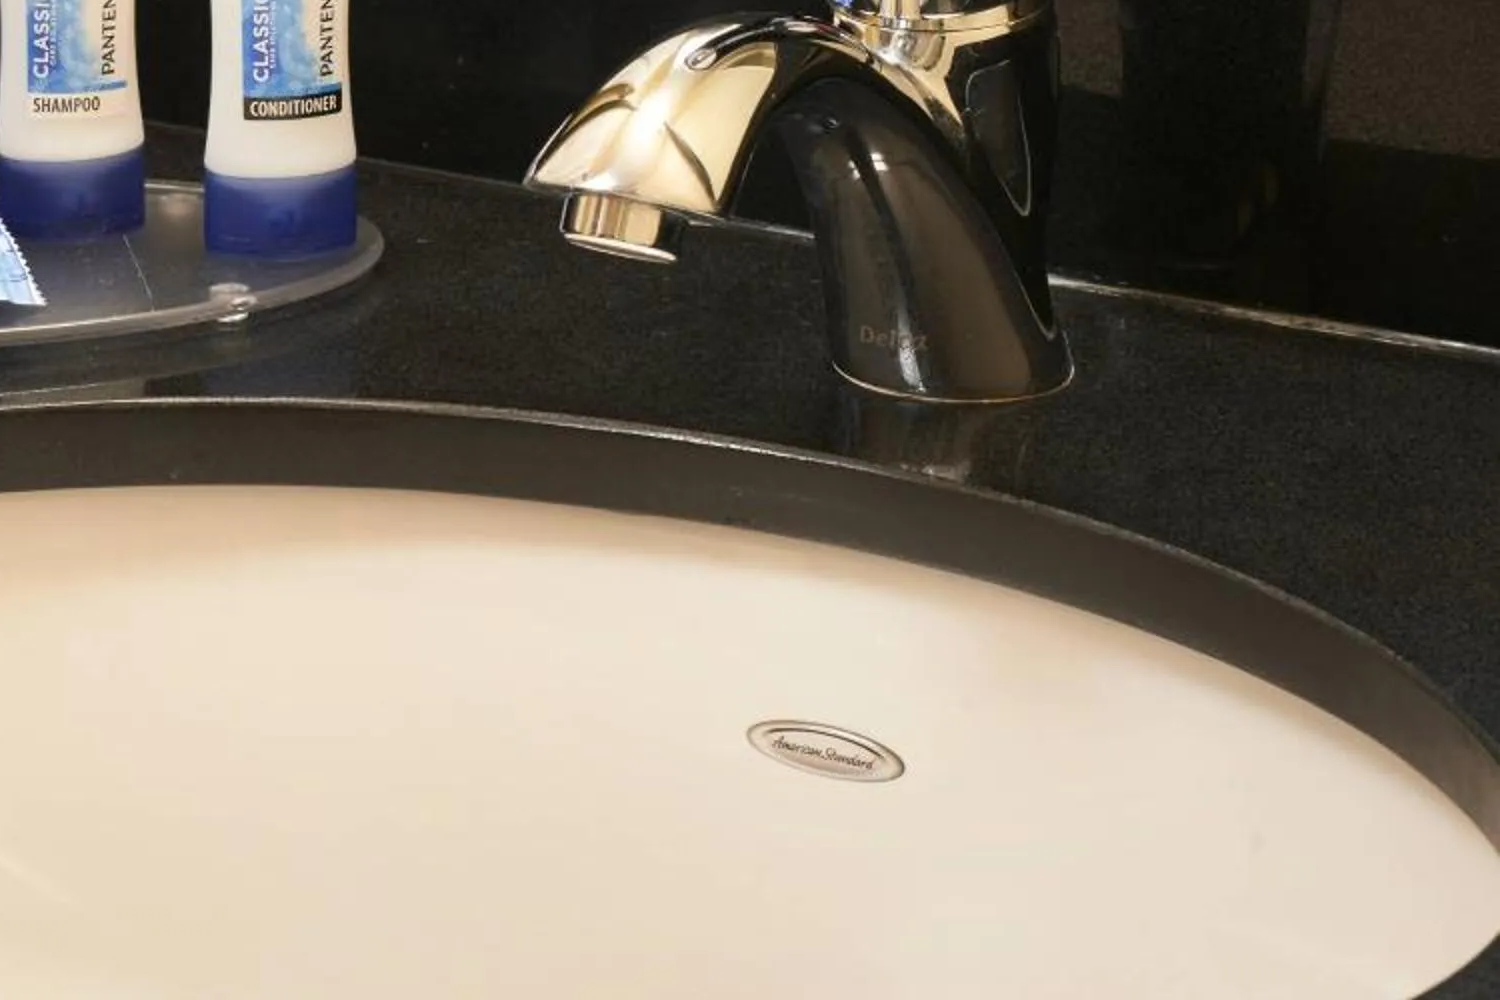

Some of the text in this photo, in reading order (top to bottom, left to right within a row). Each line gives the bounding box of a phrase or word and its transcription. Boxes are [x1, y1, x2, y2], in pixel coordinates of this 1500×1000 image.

[33, 96, 101, 113] SHAMPOO
[250, 94, 337, 118] CONDITIONER
[771, 735, 874, 770] American Standard
